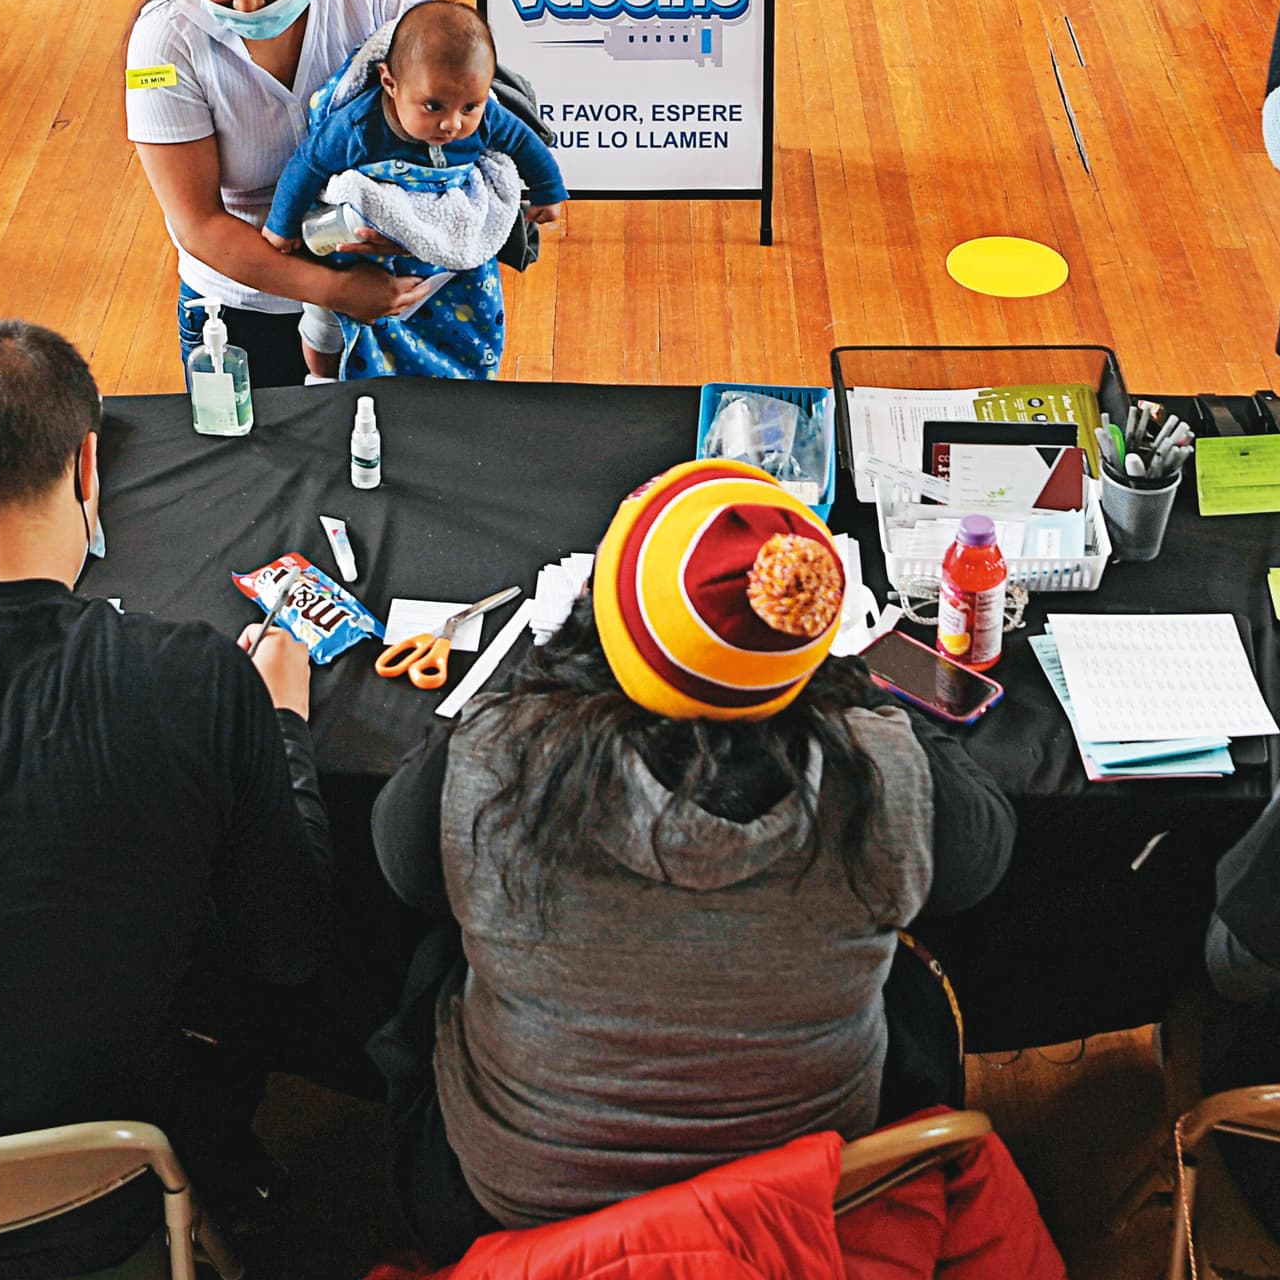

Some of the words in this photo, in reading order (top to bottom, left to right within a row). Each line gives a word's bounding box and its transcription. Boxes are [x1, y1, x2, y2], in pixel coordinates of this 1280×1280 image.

[562, 104, 644, 125] FAVOR,
[651, 104, 743, 121] ESPERE
[597, 131, 628, 148] LO
[635, 131, 729, 148] LLAMEN
